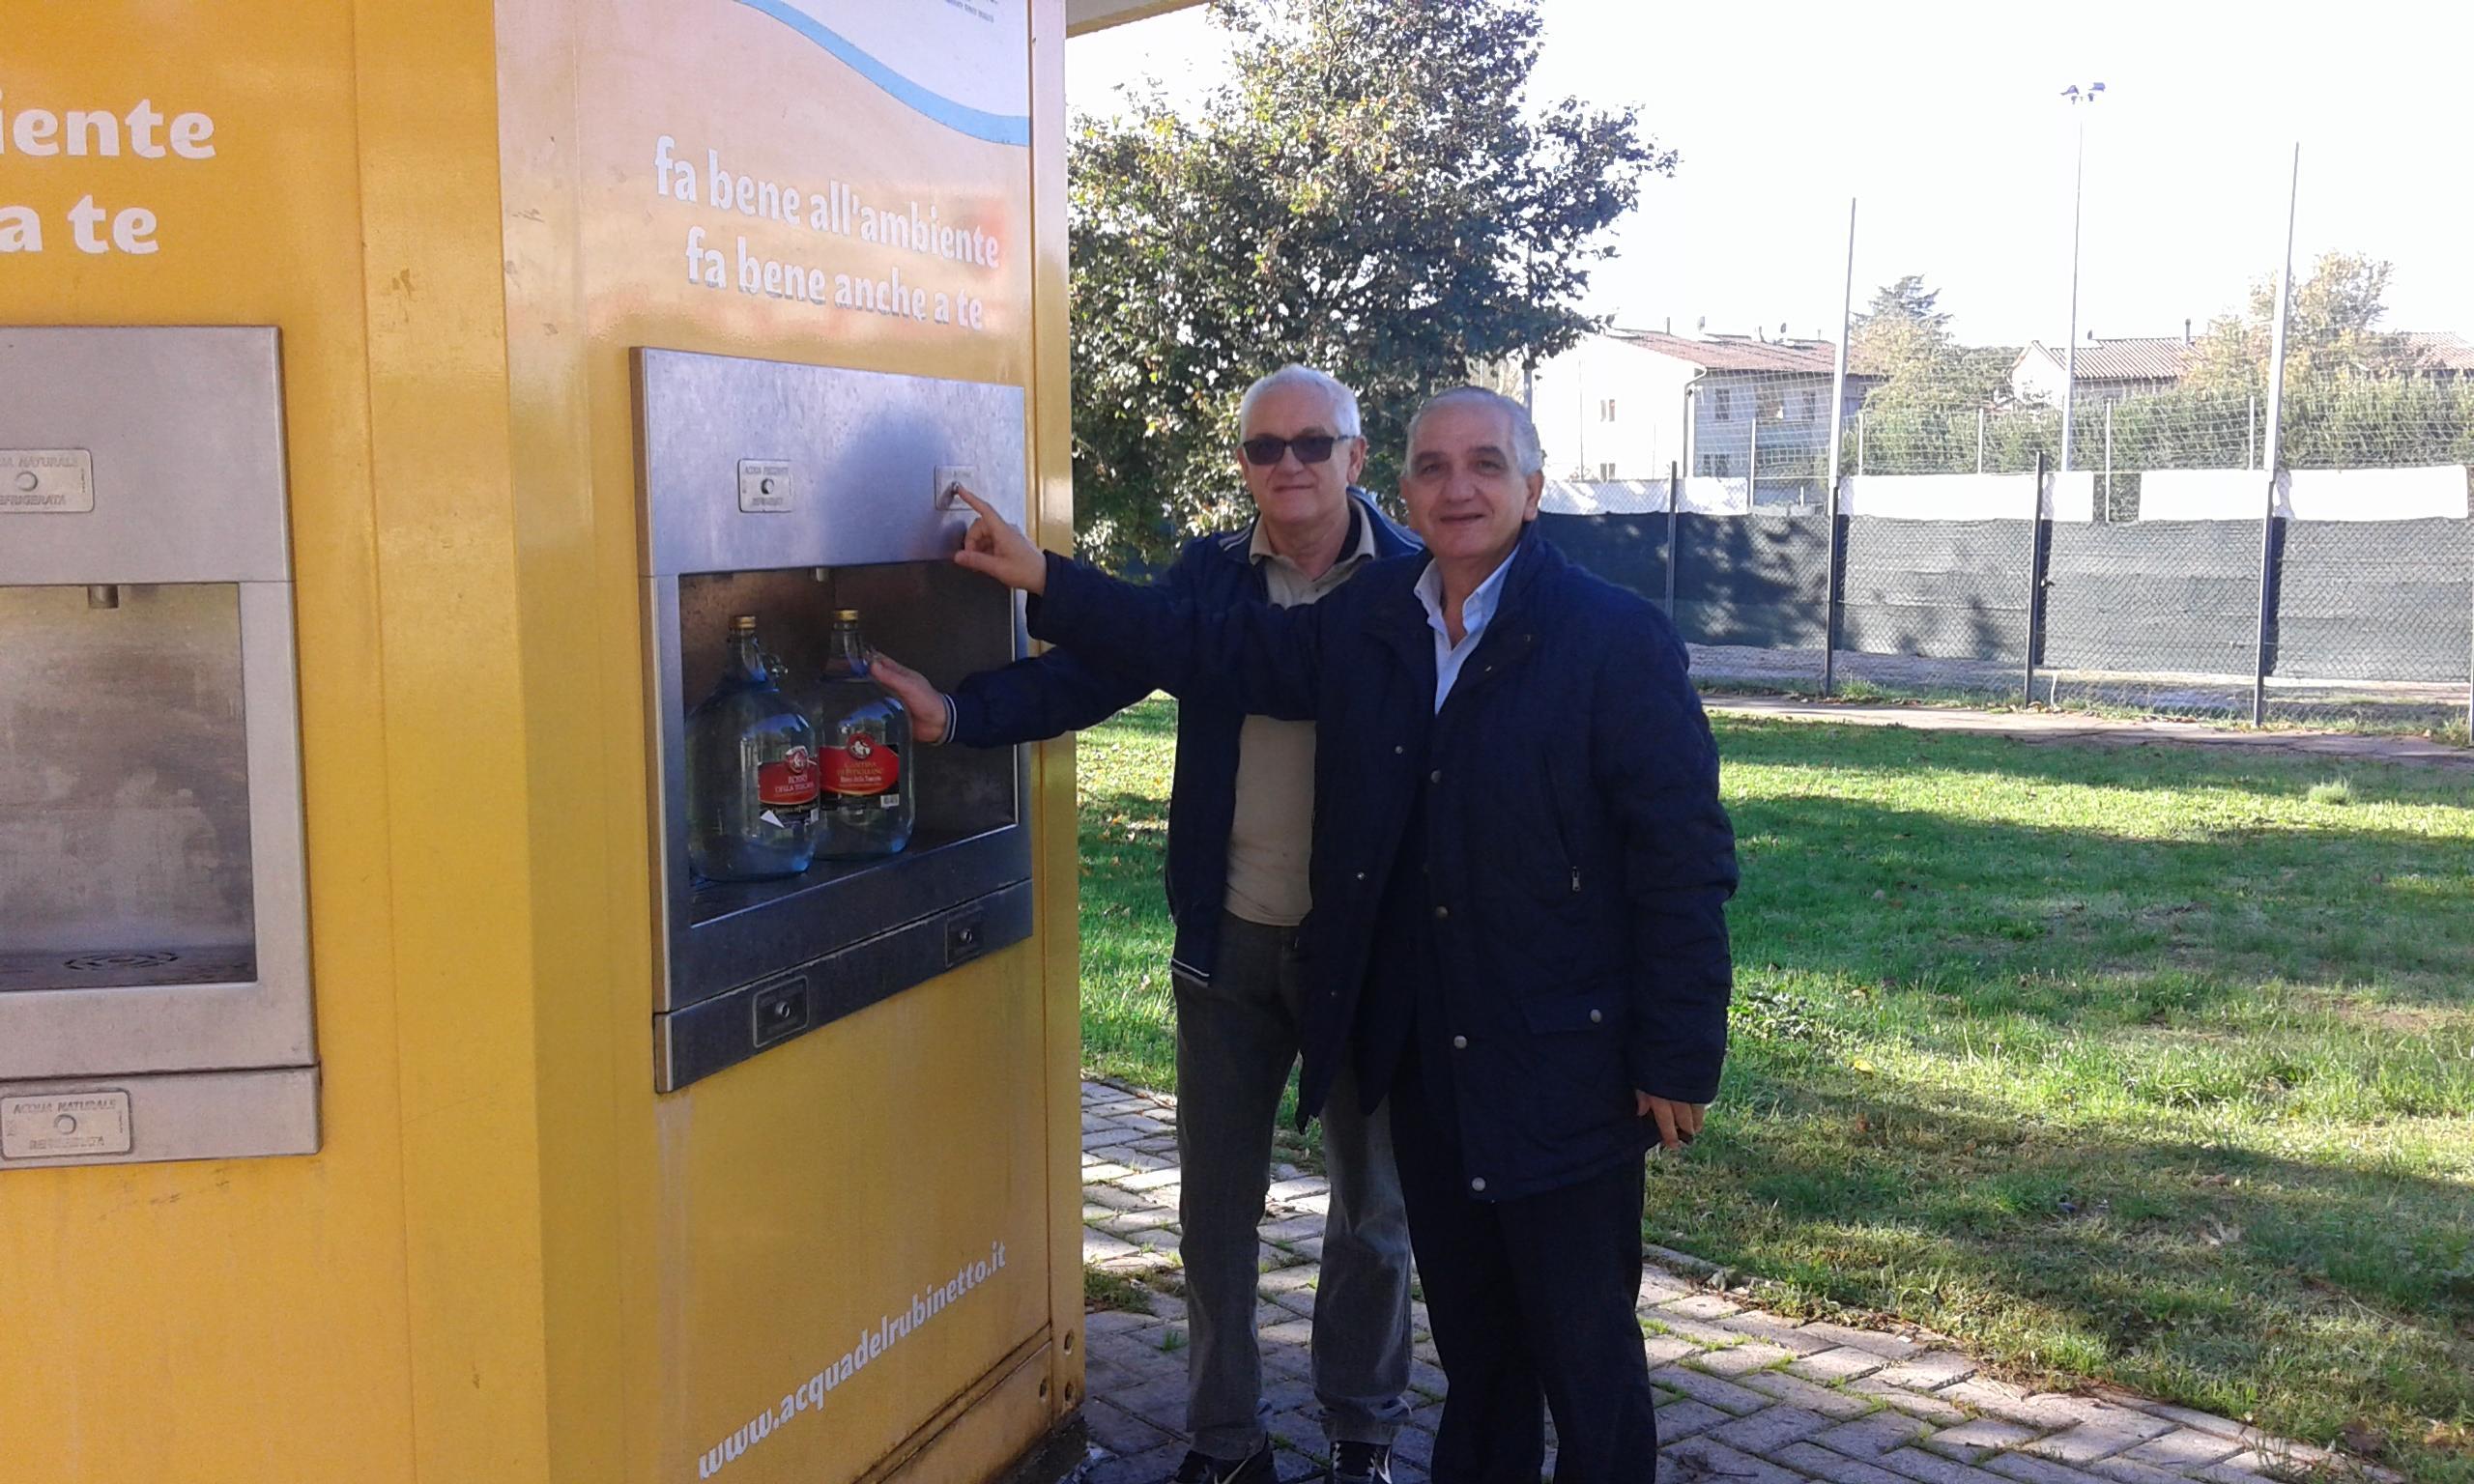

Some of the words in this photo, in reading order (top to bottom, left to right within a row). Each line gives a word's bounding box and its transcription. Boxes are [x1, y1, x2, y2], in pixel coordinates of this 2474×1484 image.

[0, 206, 43, 253] a
[68, 194, 159, 254] te
[654, 135, 697, 202] fa
[707, 148, 800, 225] bene
[809, 178, 999, 270] all'ambiente
[686, 225, 727, 288] fa
[737, 236, 825, 304] bene
[834, 267, 927, 321] anche
[934, 292, 950, 325] a
[956, 289, 984, 330] te
[699, 1241, 1006, 1480] www.acquadelrubinetto.it
